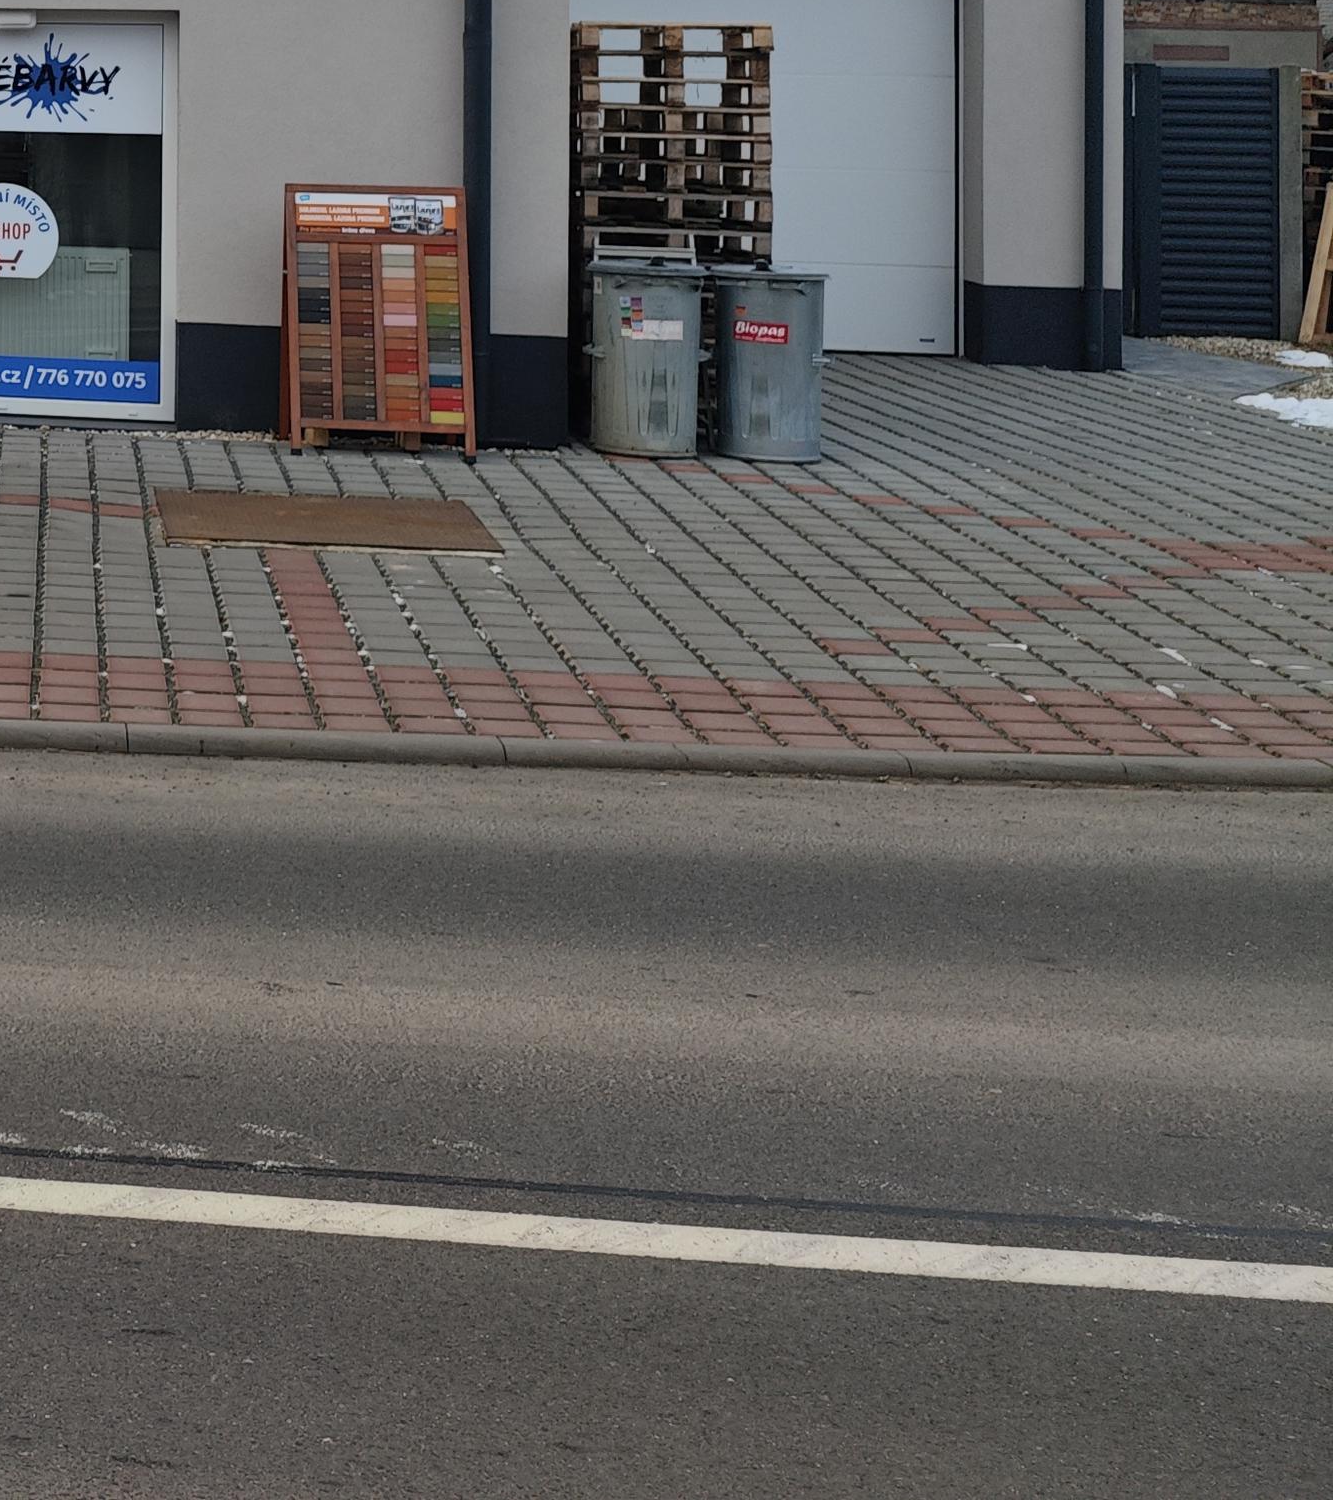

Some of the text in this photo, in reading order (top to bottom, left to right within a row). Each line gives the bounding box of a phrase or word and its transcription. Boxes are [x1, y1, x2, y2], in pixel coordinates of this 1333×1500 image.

[13, 194, 50, 232] MÍSTO
[734, 321, 786, 338] Biopas
[36, 367, 69, 386] 776
[73, 369, 107, 388] 770
[111, 370, 147, 389] 075
